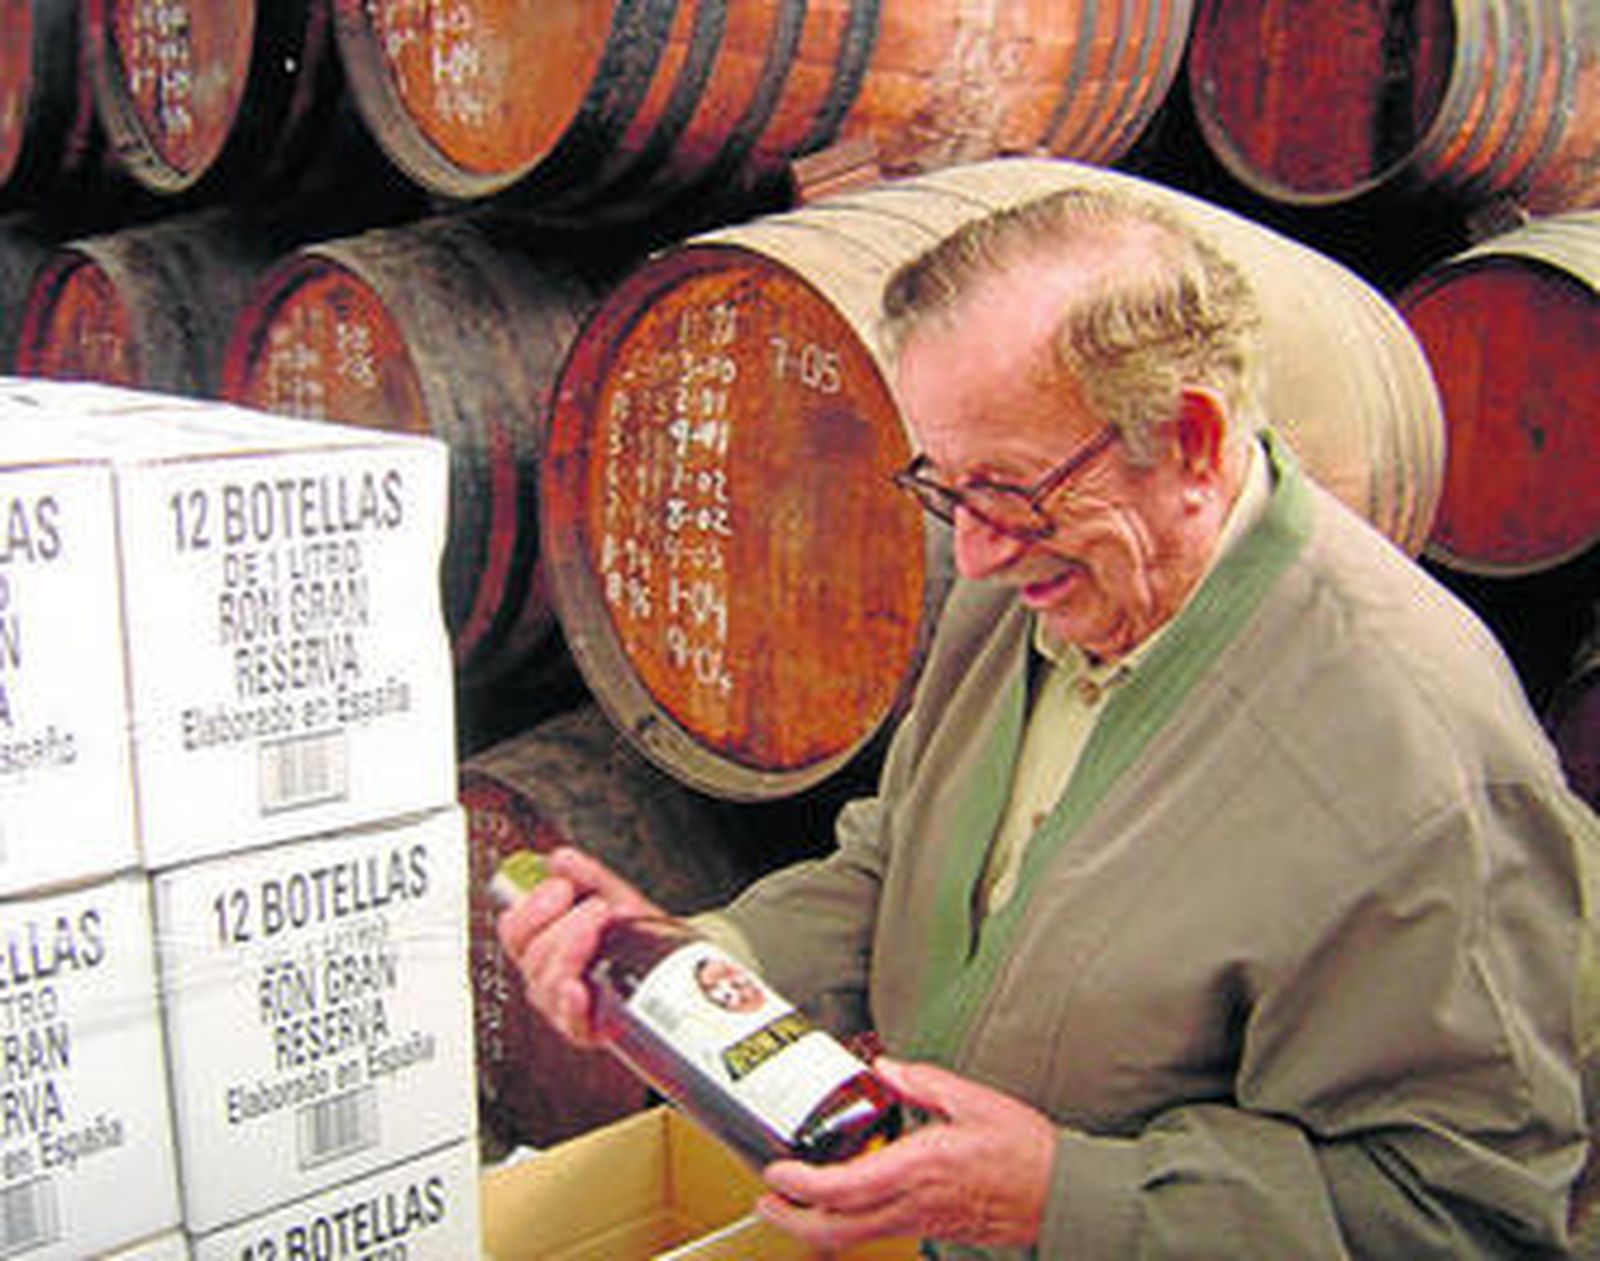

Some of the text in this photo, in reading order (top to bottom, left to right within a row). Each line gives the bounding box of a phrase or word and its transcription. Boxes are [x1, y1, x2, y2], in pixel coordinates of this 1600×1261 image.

[170, 470, 404, 552] 12 BOTELLAS
[223, 551, 258, 590] DE
[290, 539, 363, 581] LITRO
[219, 577, 369, 645] RON GRAN
[234, 634, 361, 700] RESERVA
[182, 697, 295, 752] Elaborado
[303, 697, 328, 728] en
[214, 845, 428, 944] 12 BOTELLAS
[260, 953, 398, 1024] RON GRAN
[274, 998, 389, 1071] RESERVA
[227, 1066, 329, 1126] Elaborado
[336, 1060, 360, 1085] en
[286, 1180, 445, 1261] BOTELLAS
